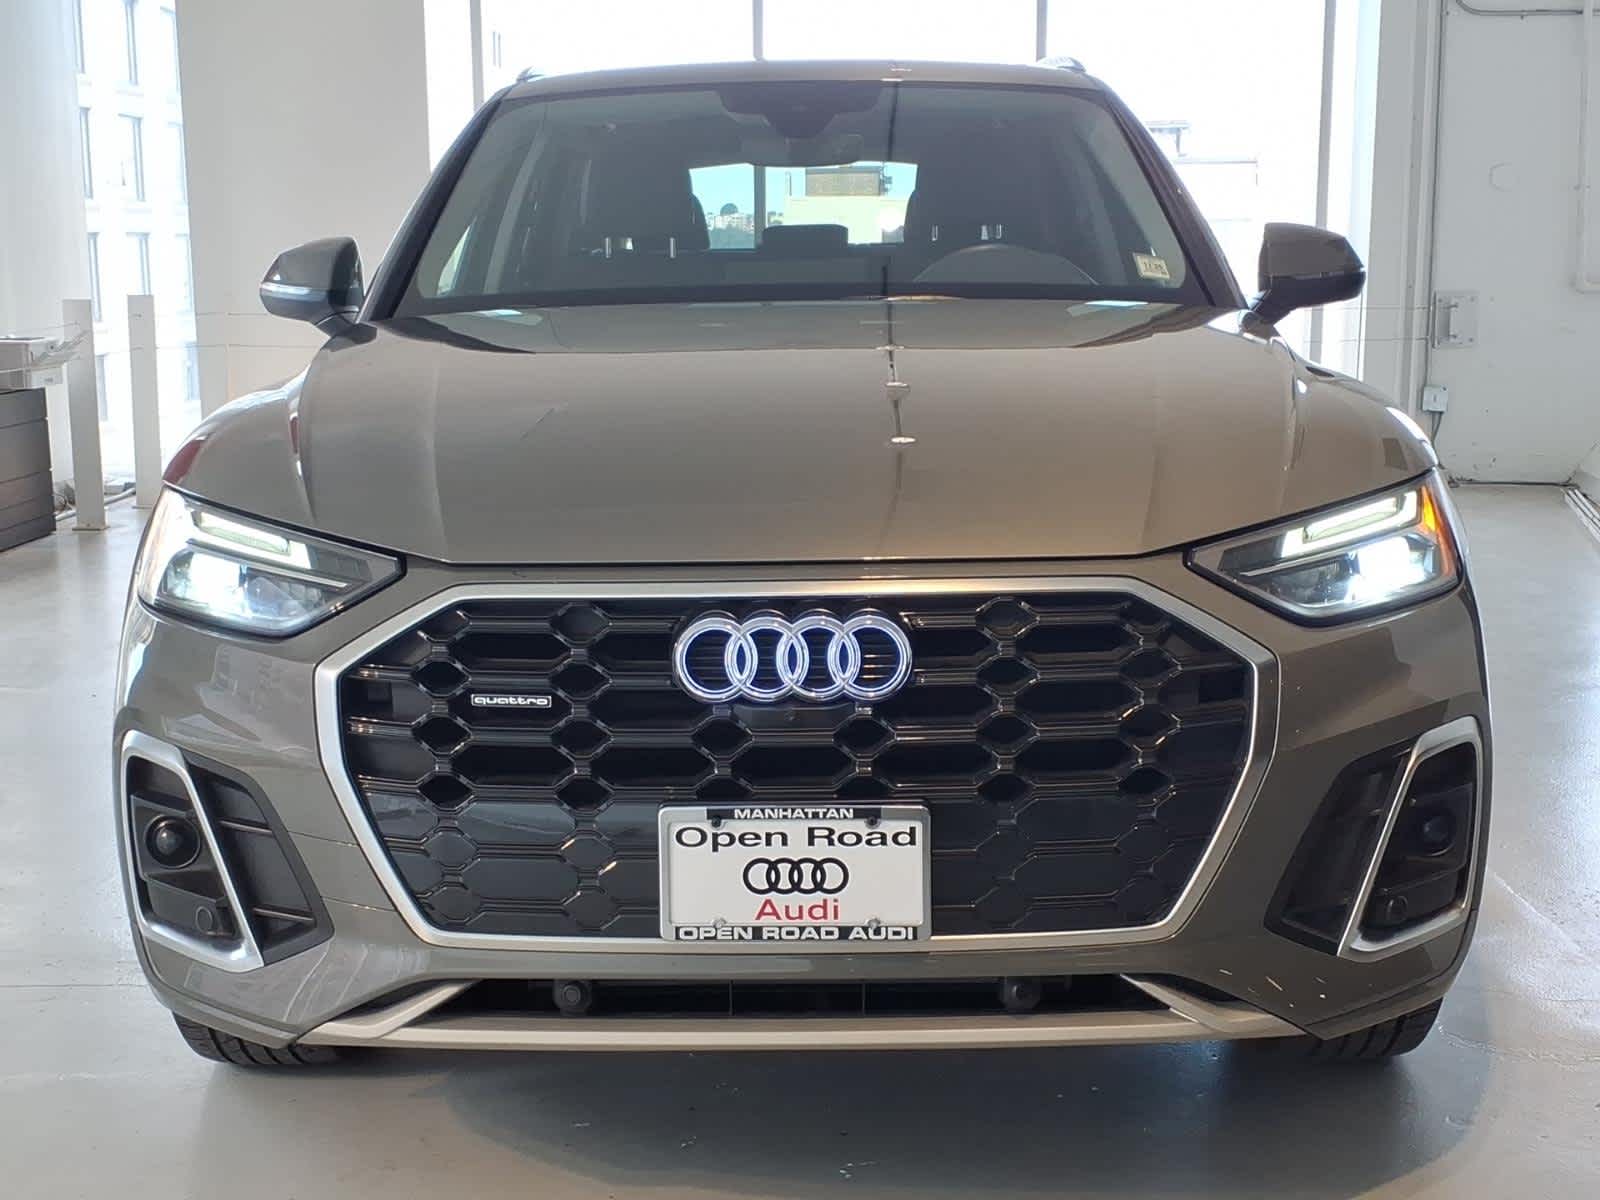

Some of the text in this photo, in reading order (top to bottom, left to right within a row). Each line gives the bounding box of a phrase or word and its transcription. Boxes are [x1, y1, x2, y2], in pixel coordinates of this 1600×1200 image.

[474, 696, 548, 705] quattro
[734, 808, 854, 819] MANHATTAN
[675, 826, 917, 852] Open Road
[755, 898, 839, 921] Audi
[679, 926, 914, 940] OPEN ROAD AUDI
